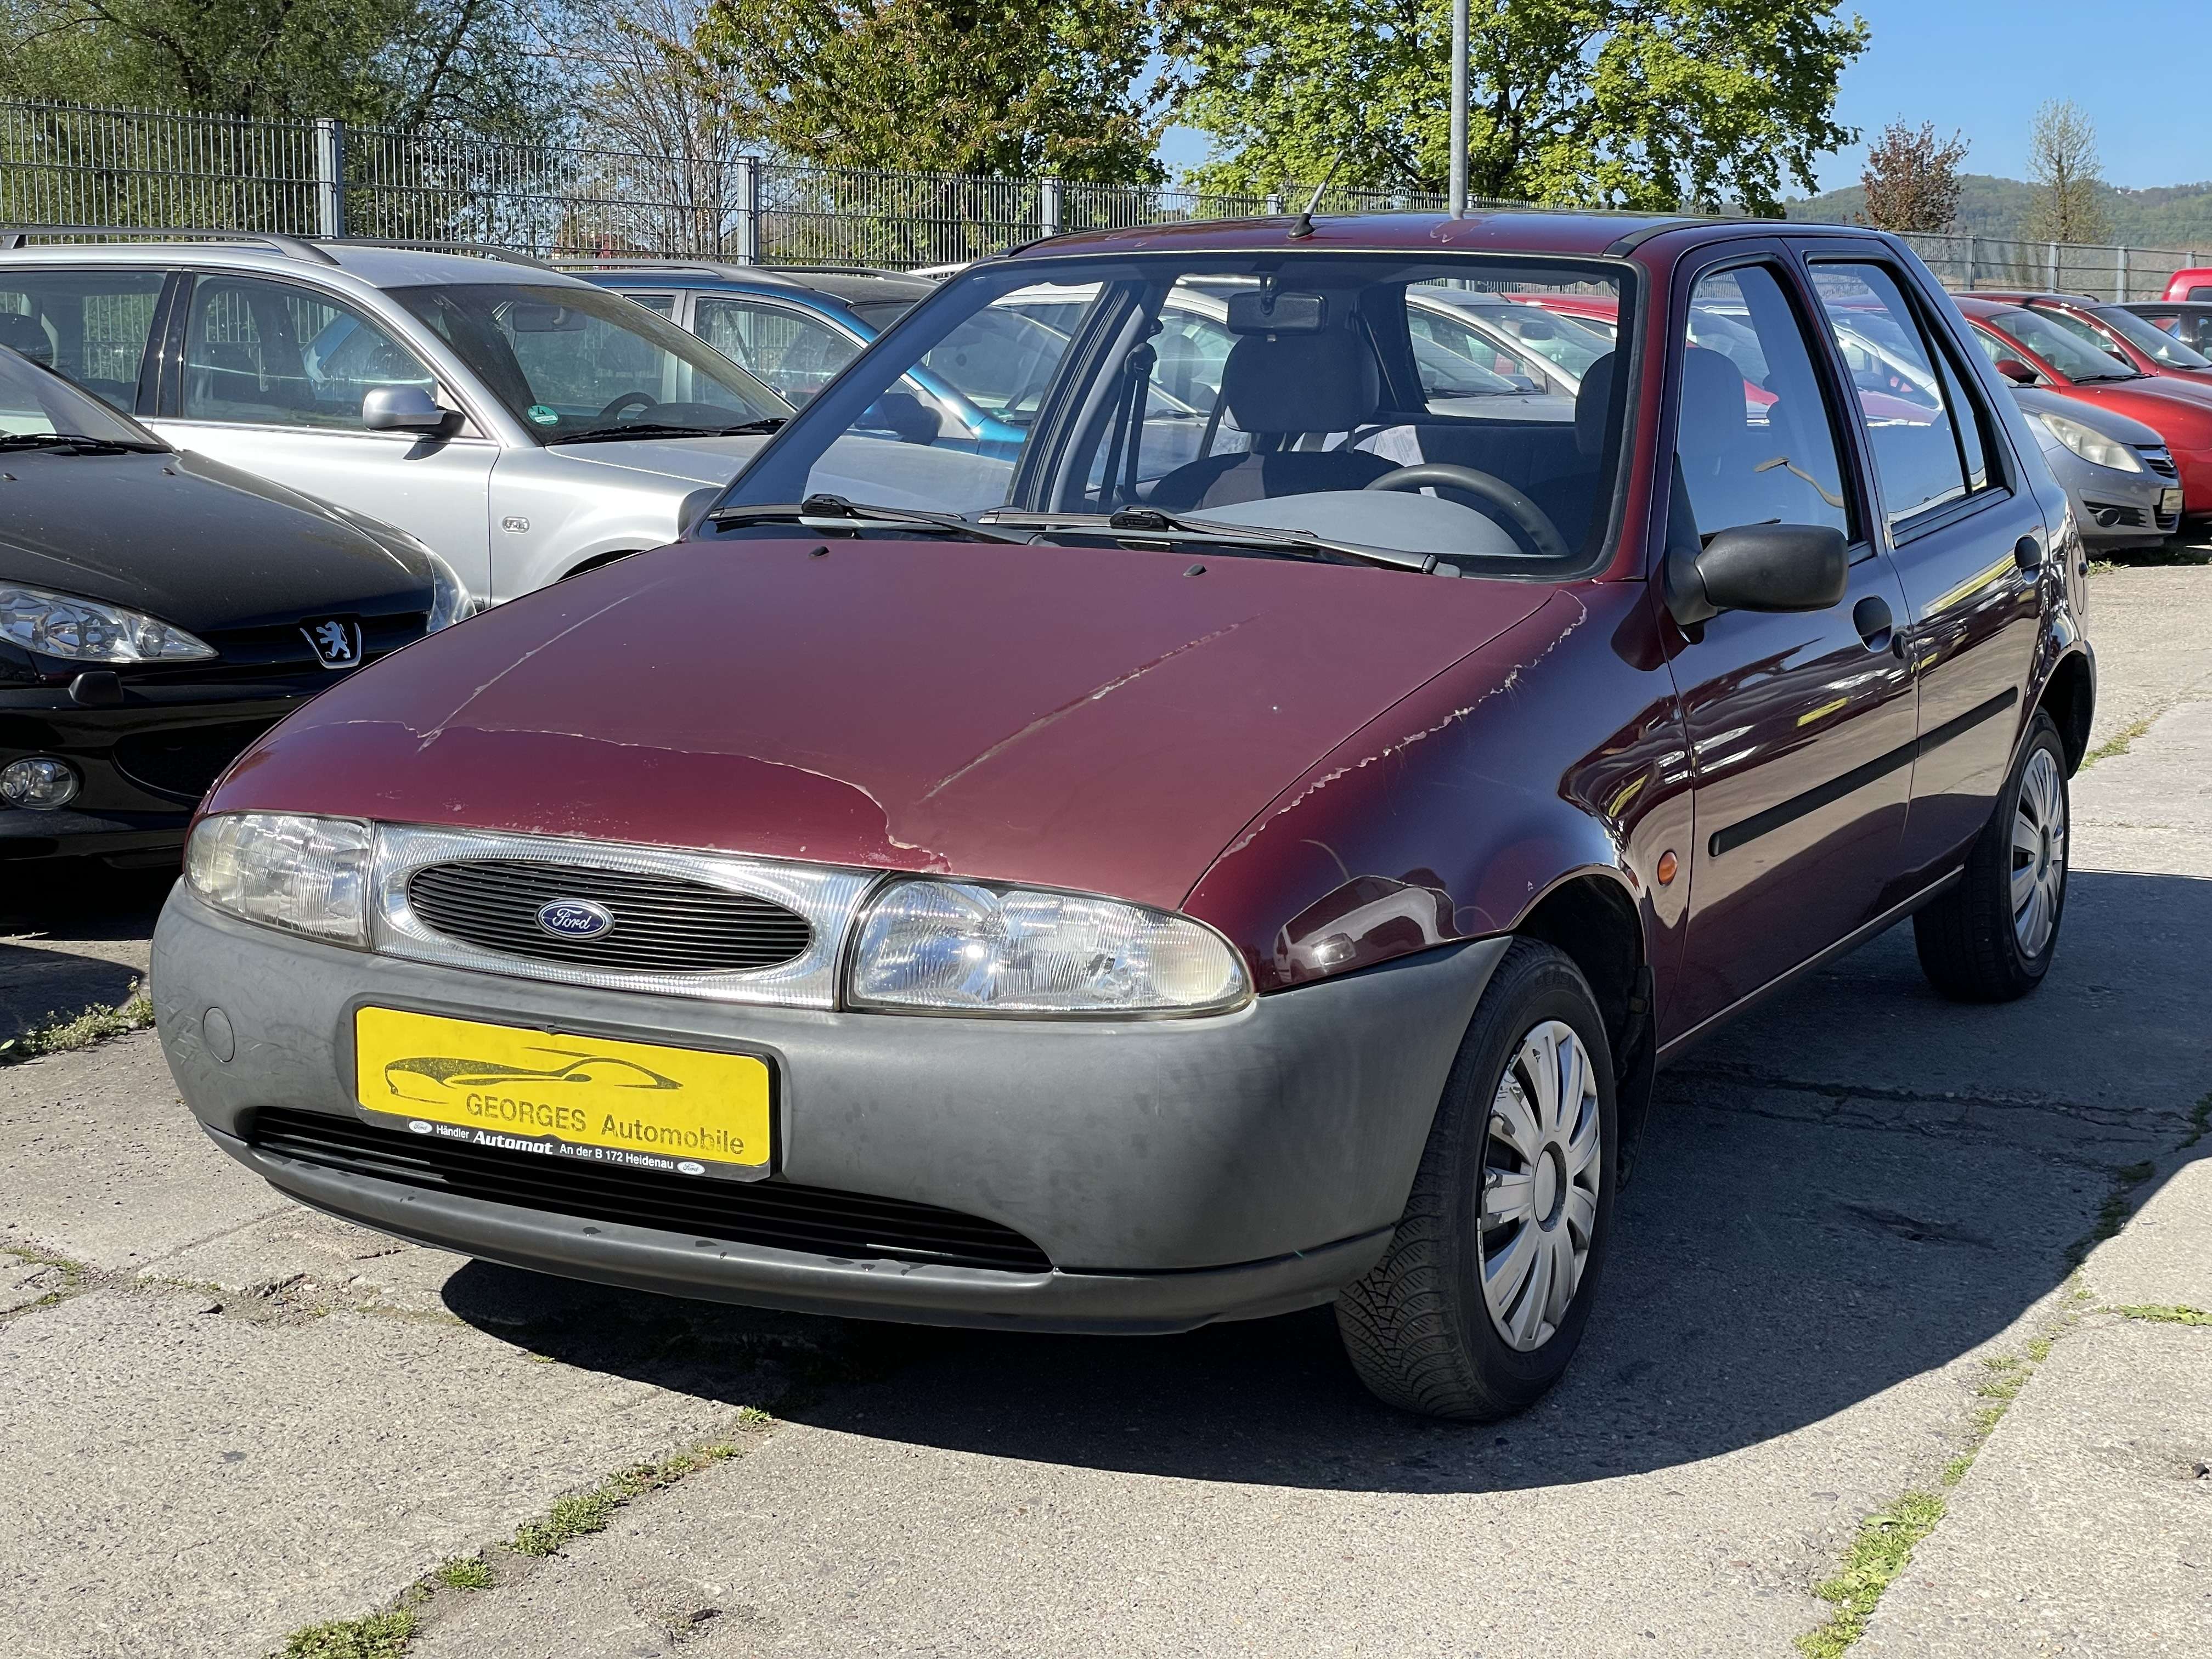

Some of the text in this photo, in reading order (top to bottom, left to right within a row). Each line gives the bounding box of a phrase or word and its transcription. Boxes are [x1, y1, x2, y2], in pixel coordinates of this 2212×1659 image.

[552, 908, 592, 930] Ford
[466, 1093, 744, 1155] GEORGES Automobile
[436, 1124, 674, 1170] Händler Automot An der B 172 Heidenau
[683, 1163, 699, 1172] Ford
